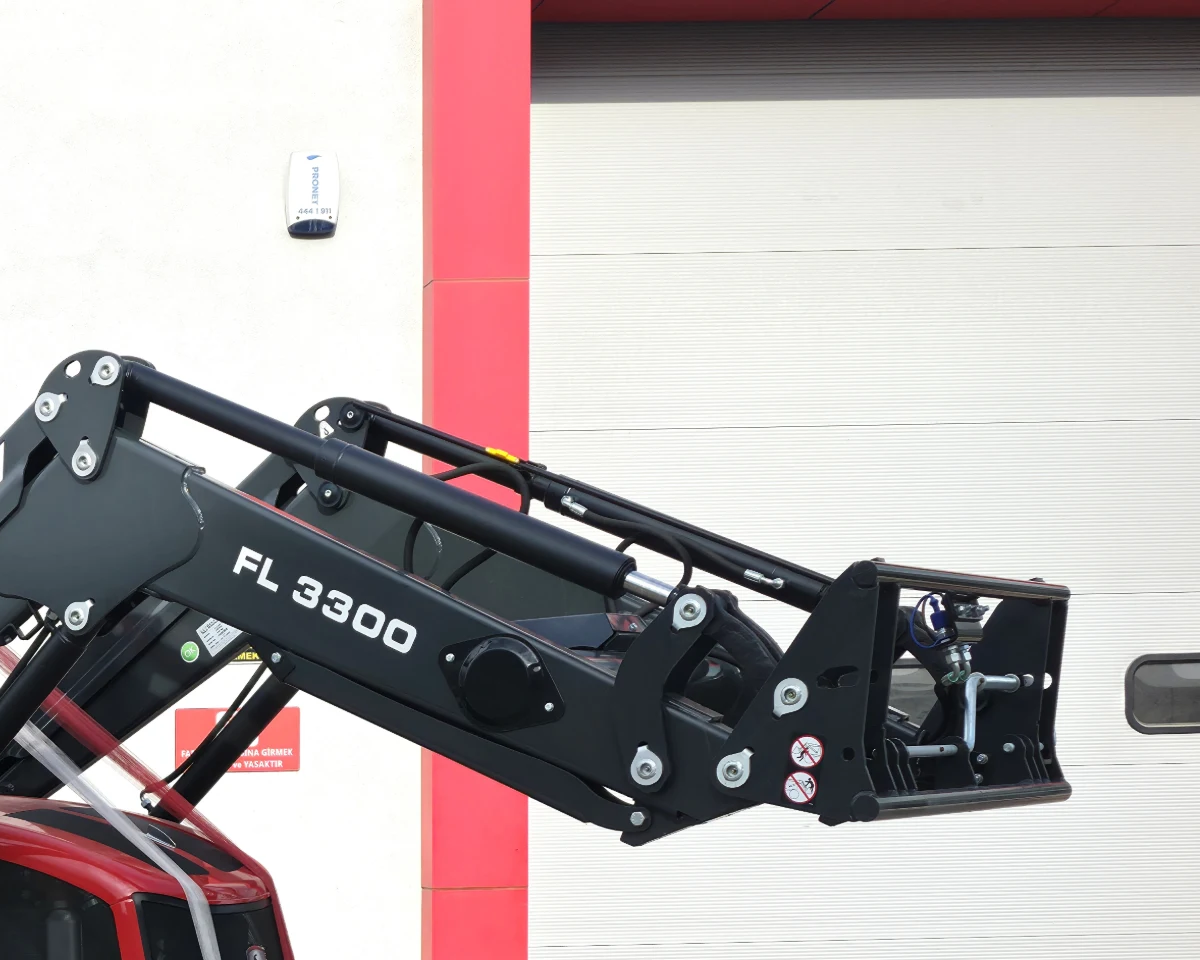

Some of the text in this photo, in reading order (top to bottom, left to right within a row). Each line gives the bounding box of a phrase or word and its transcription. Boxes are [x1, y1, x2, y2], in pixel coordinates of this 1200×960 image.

[232, 545, 279, 593] FL
[292, 575, 417, 654] 3300
[261, 747, 293, 757] GİRMEK
[244, 760, 283, 768] YASAKTIR
